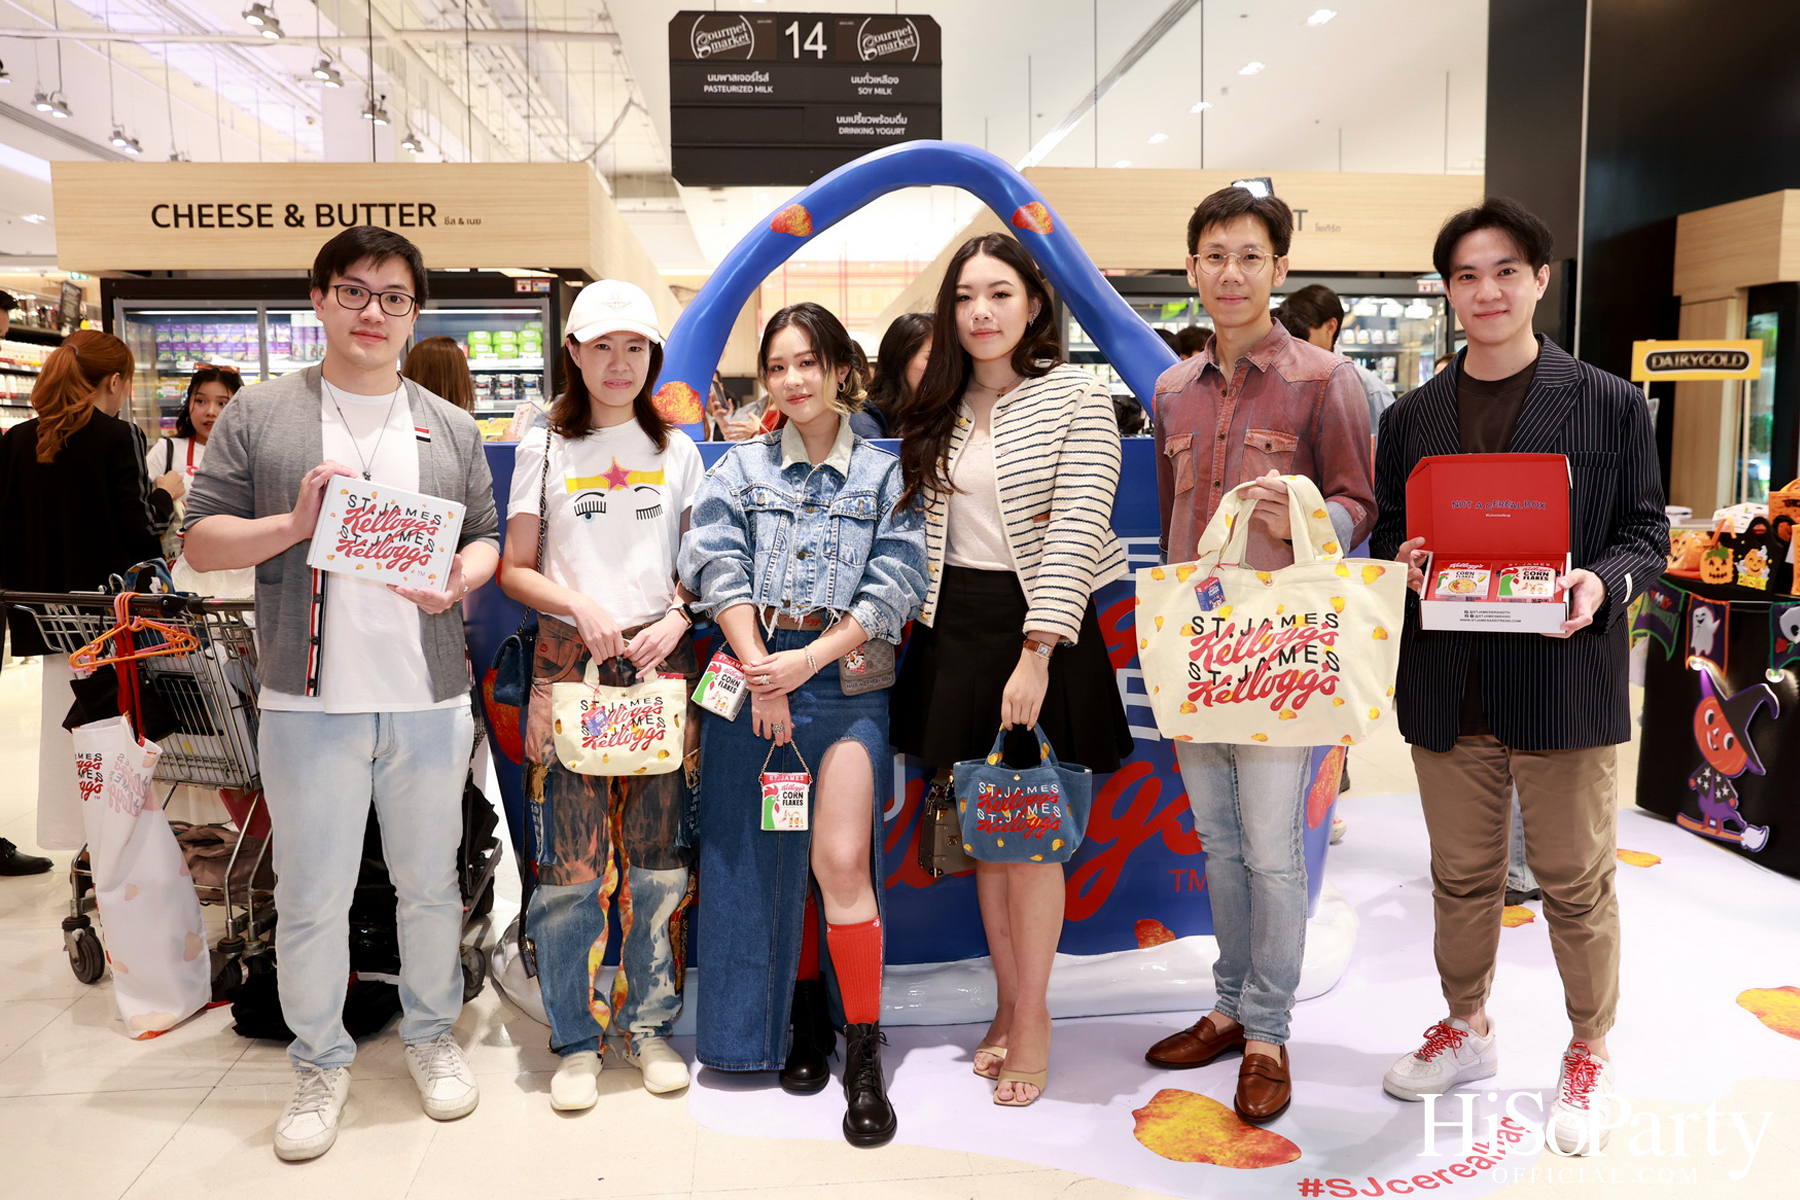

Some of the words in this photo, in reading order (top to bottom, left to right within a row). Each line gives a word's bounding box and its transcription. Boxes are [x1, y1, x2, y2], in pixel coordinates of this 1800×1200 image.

[710, 32, 750, 50] market
[784, 20, 827, 60] 14
[877, 35, 915, 53] market
[851, 72, 899, 84] นมถั่วเหลือง
[704, 85, 753, 93] PASTEURIZED
[755, 85, 773, 94] MILK
[858, 87, 873, 95] SOY
[874, 87, 893, 95] MILK
[838, 126, 875, 135] DRINKING
[876, 127, 905, 135] YOGURT
[151, 203, 274, 228] CHEESE
[284, 203, 306, 228] &
[316, 203, 437, 228] BUTTER
[1651, 353, 1746, 368] DAIRYGOLD
[1451, 500, 1473, 509] NOT
[1475, 501, 1483, 509] A
[1485, 500, 1523, 511] CEREAL
[1524, 500, 1546, 509] BOX
[718, 681, 737, 694] FLAKES
[721, 674, 741, 688] CORN
[783, 791, 804, 799] CORN
[1169, 869, 1207, 892] TM
